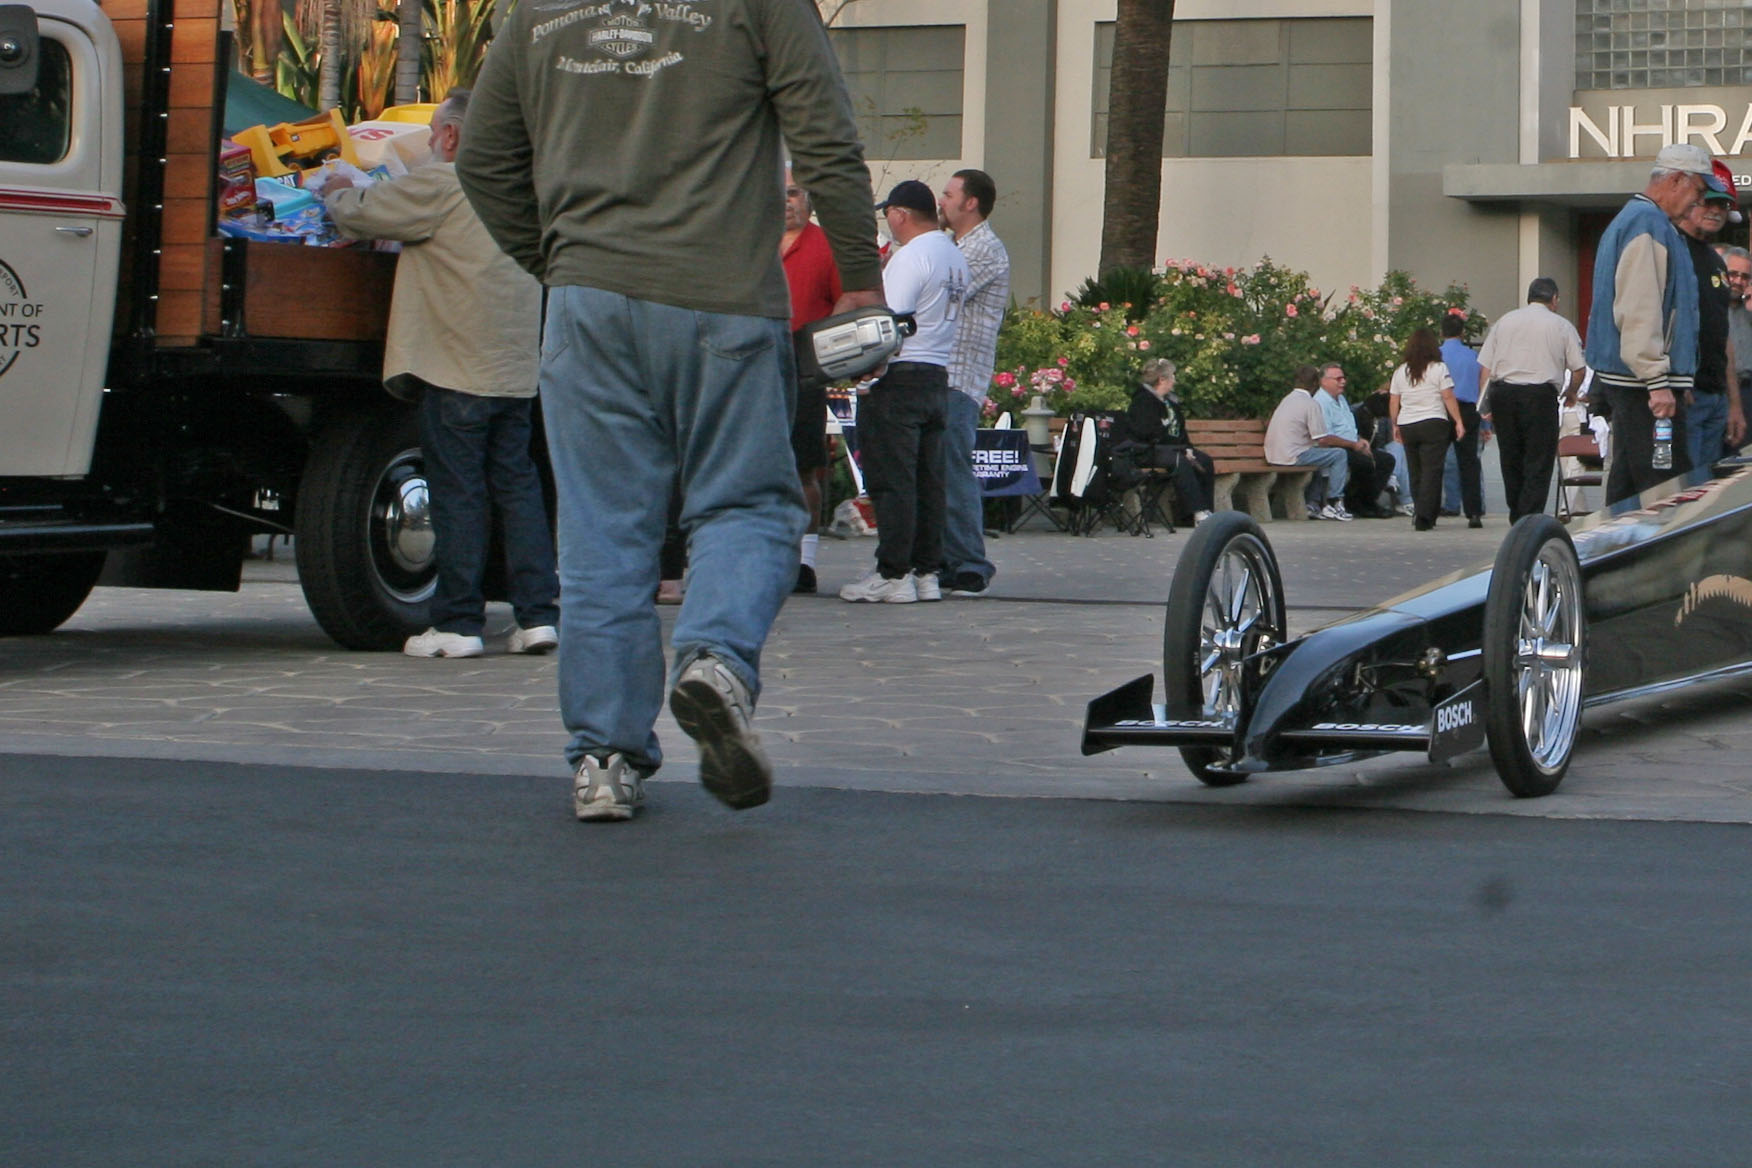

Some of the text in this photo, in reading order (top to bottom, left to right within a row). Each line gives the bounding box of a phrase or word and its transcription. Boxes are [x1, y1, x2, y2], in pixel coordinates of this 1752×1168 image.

[532, 2, 712, 45] Pomona Valley
[625, 51, 684, 79] California
[22, 303, 44, 317] OF
[1312, 722, 1424, 731] BOSCH
[1437, 701, 1473, 732] BOSCH
